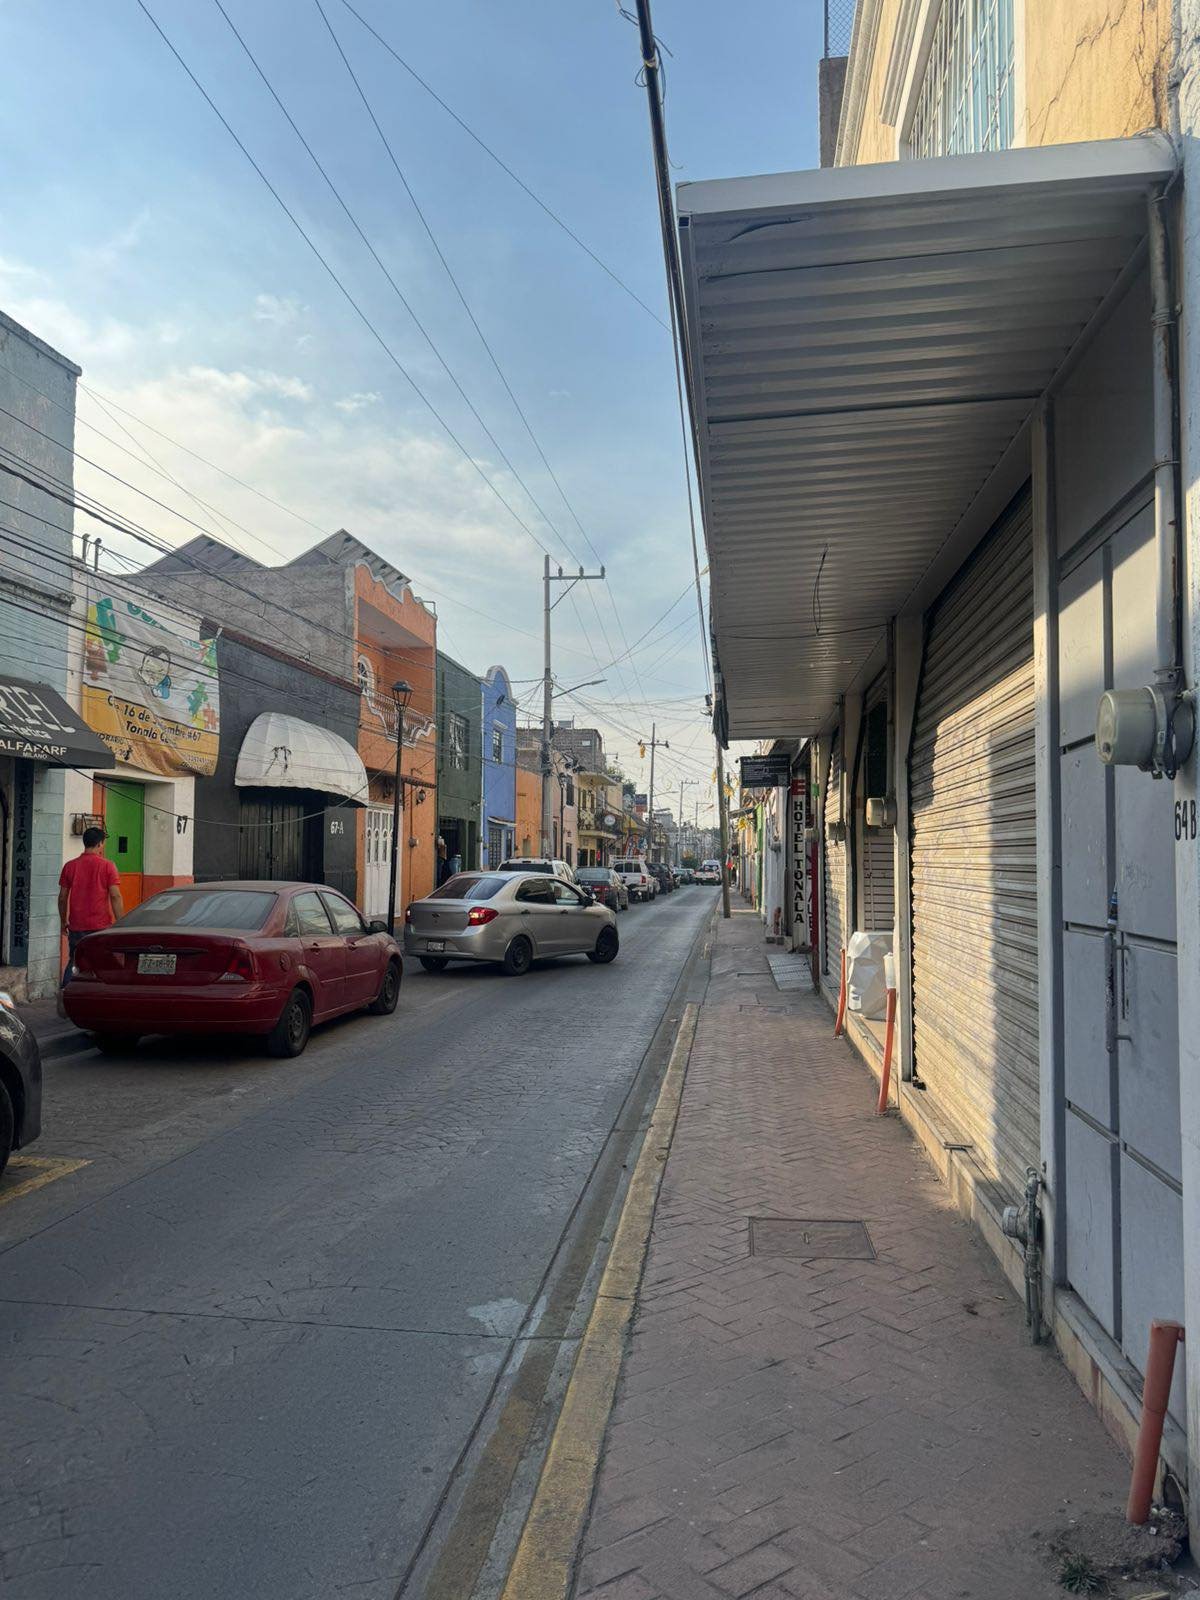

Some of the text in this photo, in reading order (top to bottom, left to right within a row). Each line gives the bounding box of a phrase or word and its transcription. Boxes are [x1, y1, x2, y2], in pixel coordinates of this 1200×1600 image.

[124, 704, 135, 718] 16
[138, 709, 150, 723] de
[176, 815, 189, 834] 67
[793, 801, 805, 923] HOTEL TONALA
